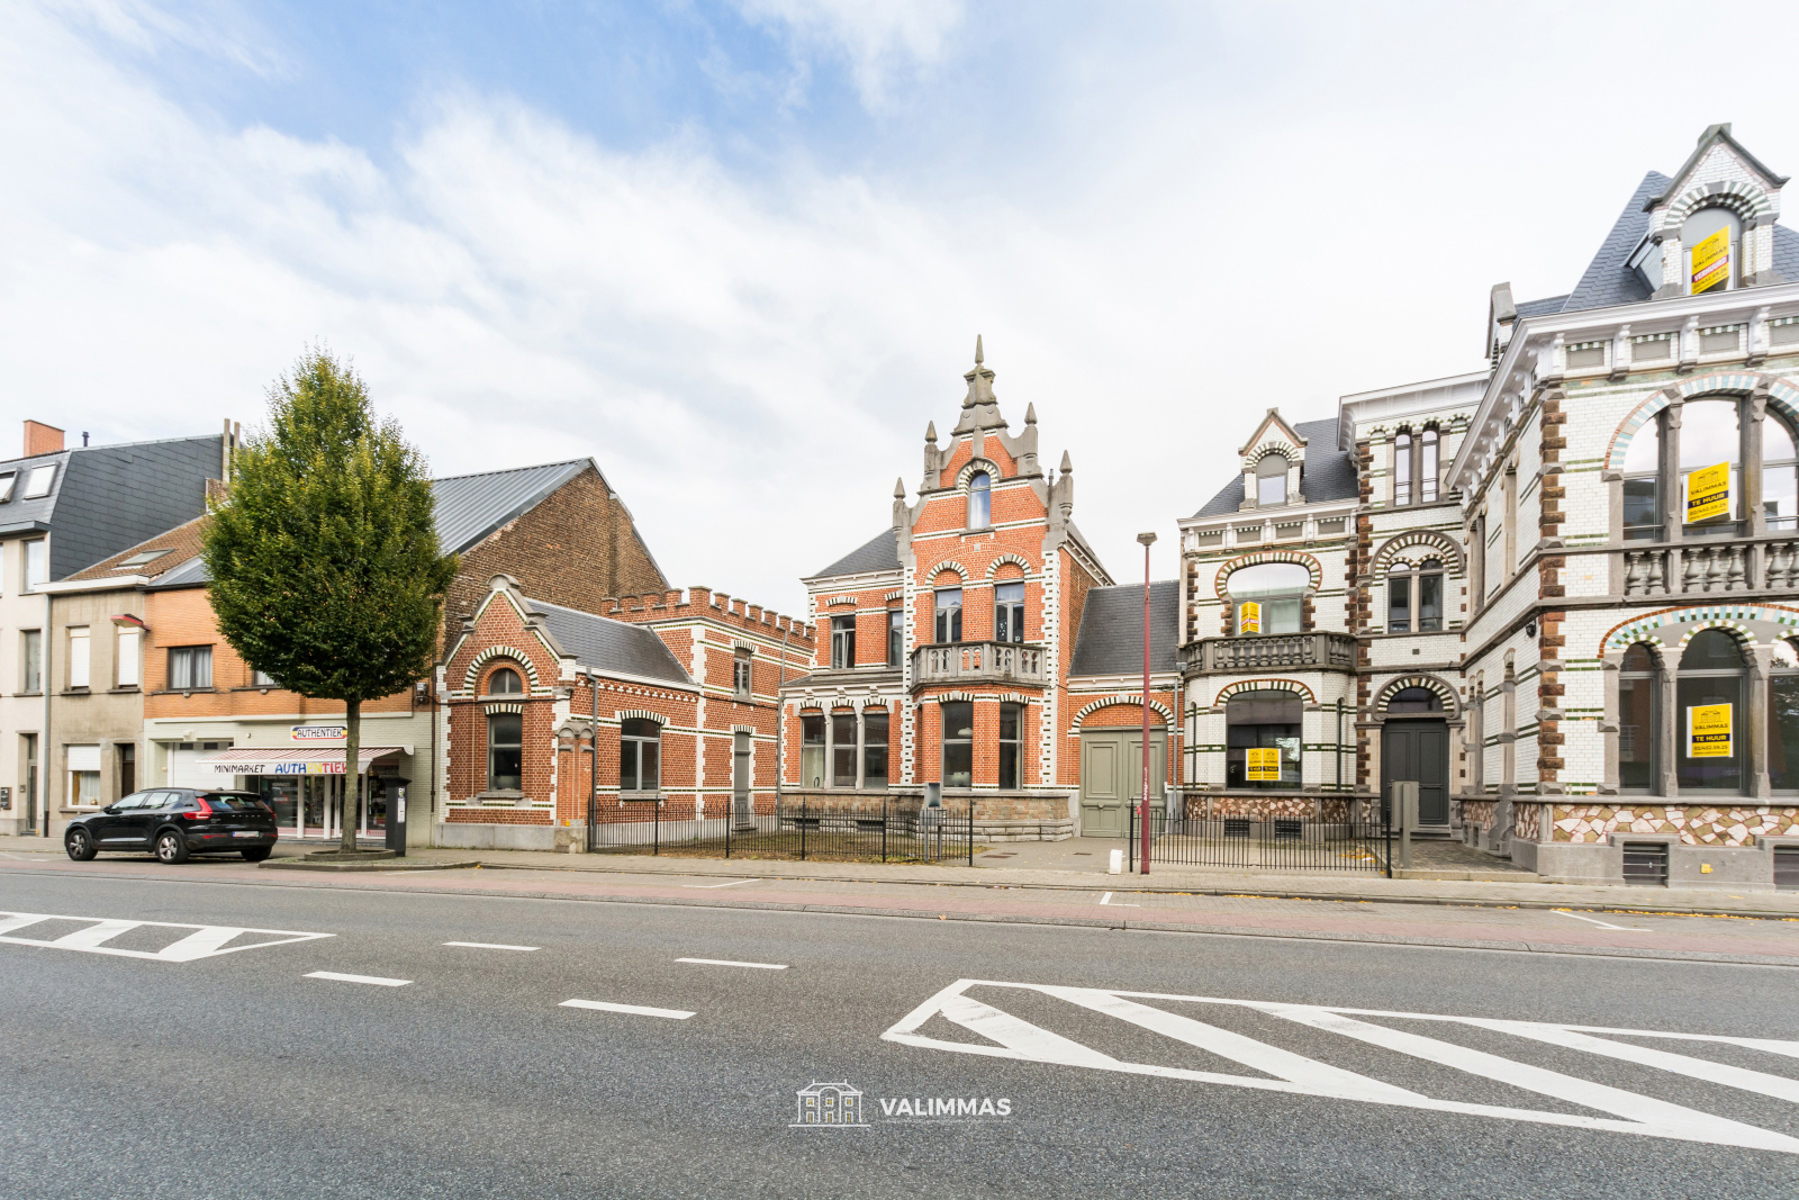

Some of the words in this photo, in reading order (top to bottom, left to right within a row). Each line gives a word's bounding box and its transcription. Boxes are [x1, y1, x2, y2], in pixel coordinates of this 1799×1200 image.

[1690, 481, 1727, 495] VALIMMAS
[1692, 499, 1701, 507] TE
[1702, 492, 1725, 504] HUUR
[297, 729, 342, 737] AUTHENTIEK
[214, 764, 265, 773] MINIMARKET
